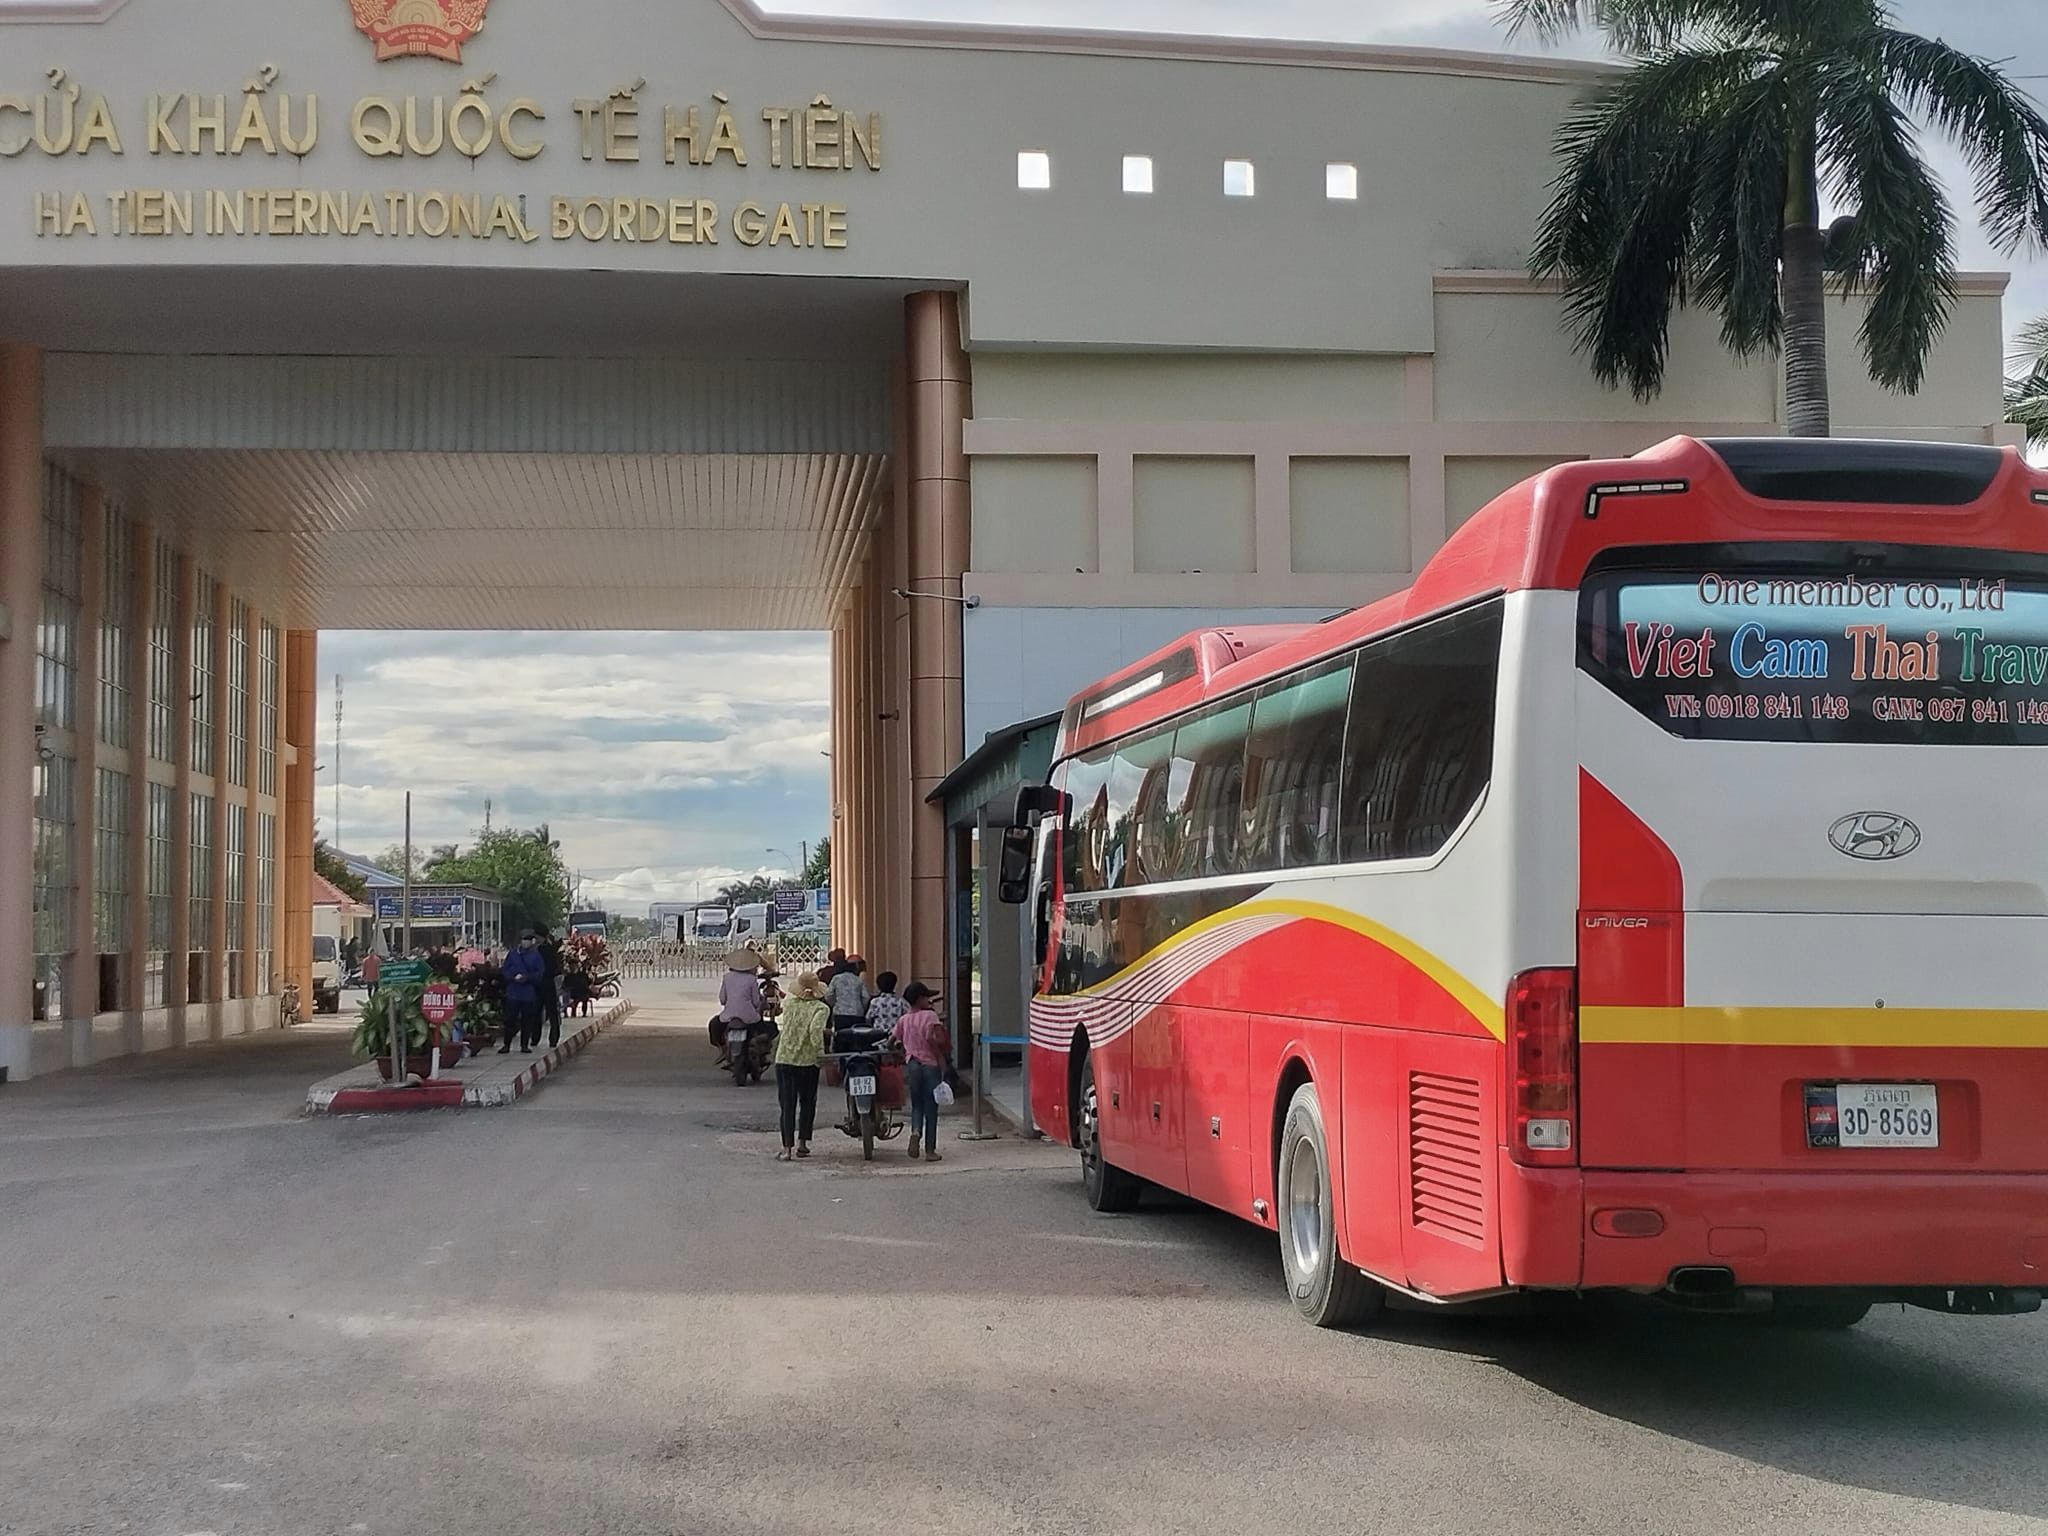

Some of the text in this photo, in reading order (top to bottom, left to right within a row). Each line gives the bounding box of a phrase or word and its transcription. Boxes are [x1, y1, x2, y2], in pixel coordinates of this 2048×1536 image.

[0, 63, 882, 171] CỬA KHẨU QUỐC TẾ HÀ TIÊN
[35, 189, 848, 248] HA TIEN INTERNATIONAL BORDER GATE
[1698, 573, 1760, 607] One
[1767, 574, 1897, 609] member
[1957, 577, 2007, 612] Ltd
[1624, 621, 1716, 679] Viet
[1729, 621, 1829, 679] Cam
[1845, 623, 1940, 681] Thai
[1664, 691, 1850, 720] VN: 0918 841 148
[1872, 695, 1925, 722] CAM:
[1927, 698, 1967, 722] 087
[1971, 696, 2009, 724] 841
[1584, 916, 1650, 929] UNIVER
[1844, 1107, 1933, 1136] 3D-8569
[1813, 1135, 1838, 1146] CAM
